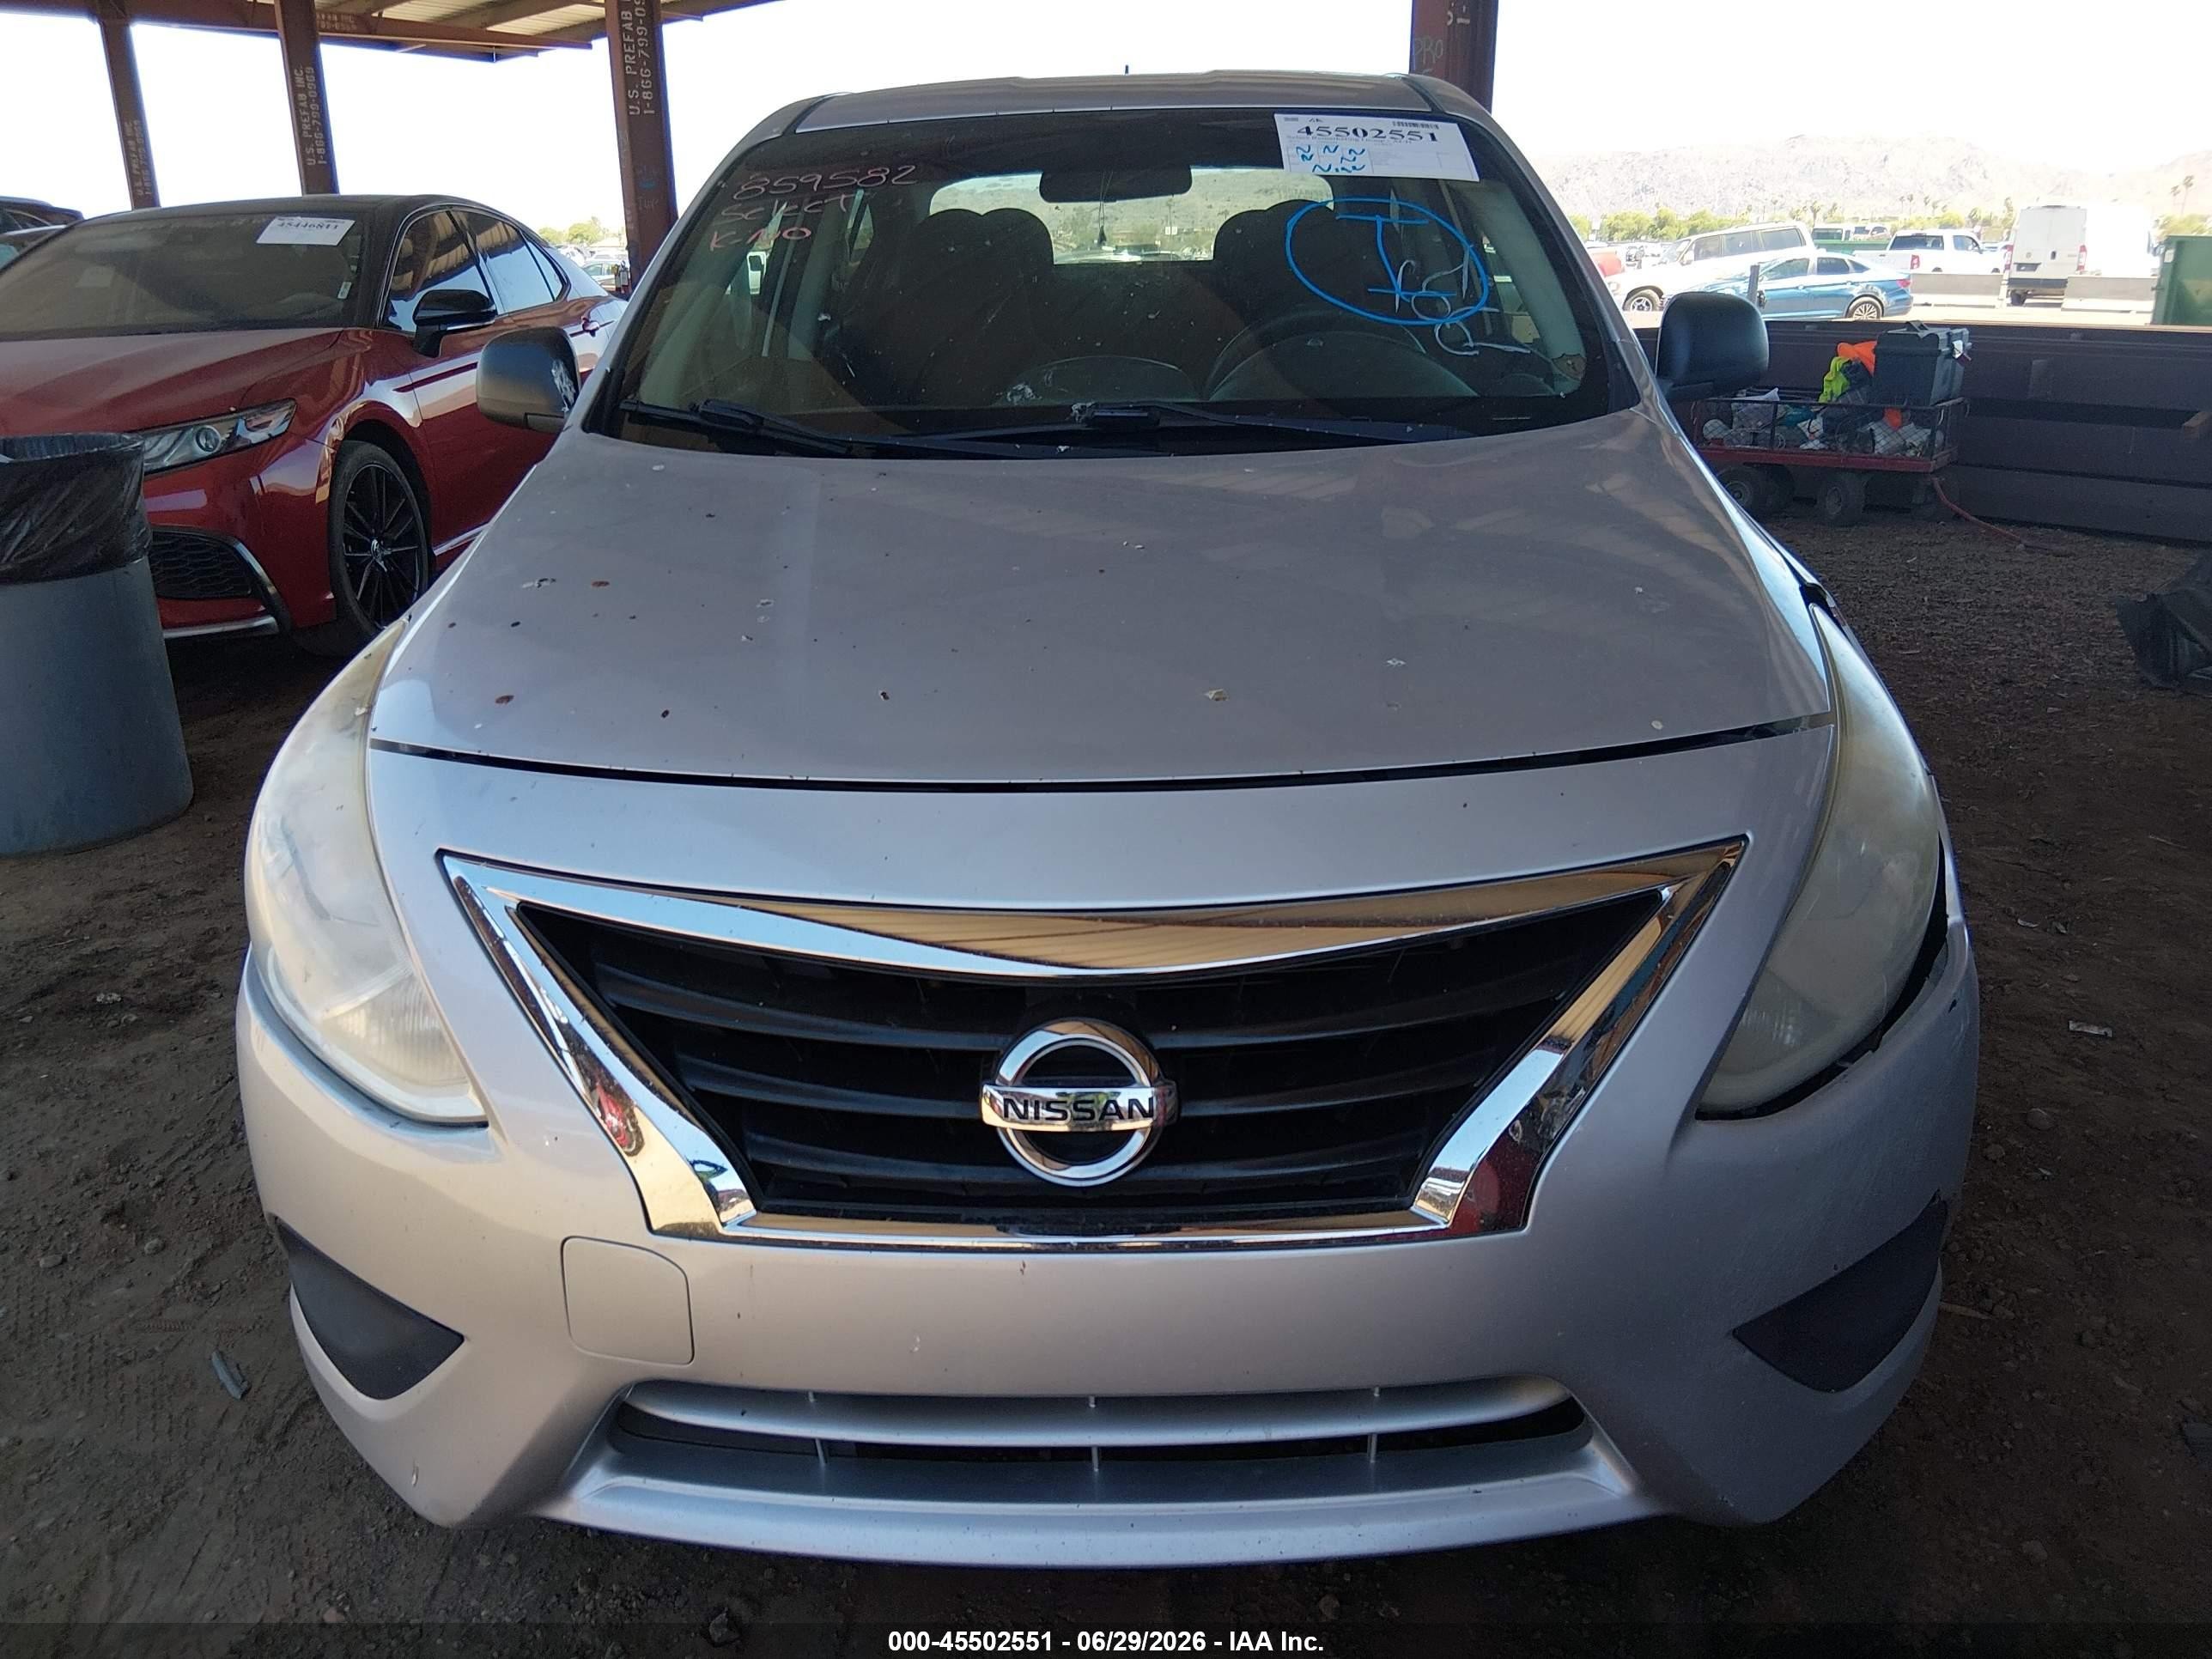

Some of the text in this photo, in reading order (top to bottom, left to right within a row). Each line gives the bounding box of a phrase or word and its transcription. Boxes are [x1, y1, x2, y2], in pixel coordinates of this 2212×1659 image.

[621, 10, 637, 75] PREFAB
[1297, 125, 1438, 143] 45502551
[733, 164, 919, 200] 859582
[1003, 1097, 1154, 1121] NISSAN
